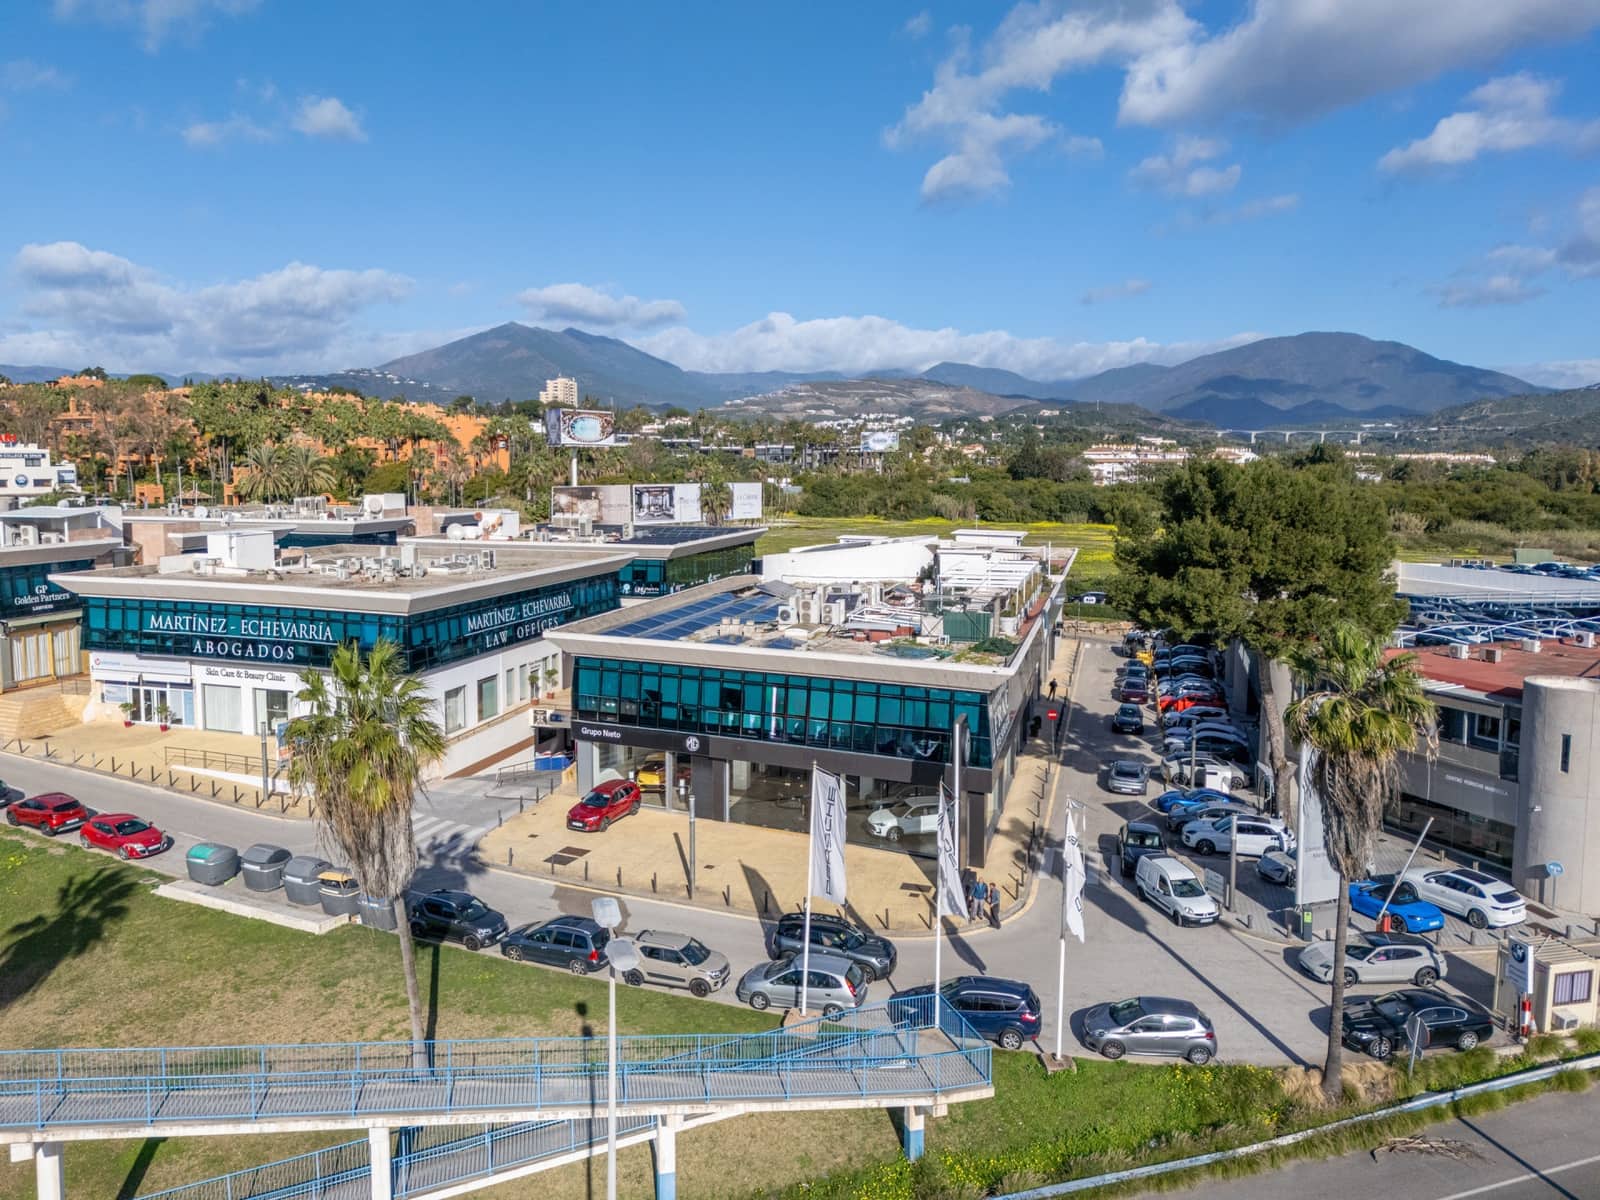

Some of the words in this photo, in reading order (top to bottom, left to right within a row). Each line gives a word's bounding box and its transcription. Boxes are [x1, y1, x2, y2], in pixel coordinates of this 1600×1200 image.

[14, 595, 40, 606] Golden
[41, 592, 70, 603] Partners
[35, 585, 48, 595] GP
[468, 607, 516, 632] MARTÍNEZ
[522, 592, 572, 618] ECHEVARRÍA
[150, 613, 227, 634] MARTÍNEZ
[241, 619, 333, 641] ECHEVARRÍA
[486, 630, 508, 648] LAW
[516, 617, 559, 639] OFFICES
[193, 639, 295, 660] ABOGADOS
[206, 667, 219, 676] Skin
[220, 668, 236, 678] Care
[236, 670, 243, 678] &
[244, 670, 265, 682] Beauty
[266, 672, 286, 682] Clinic
[581, 726, 602, 737] Grupo
[602, 729, 621, 739] Nieto
